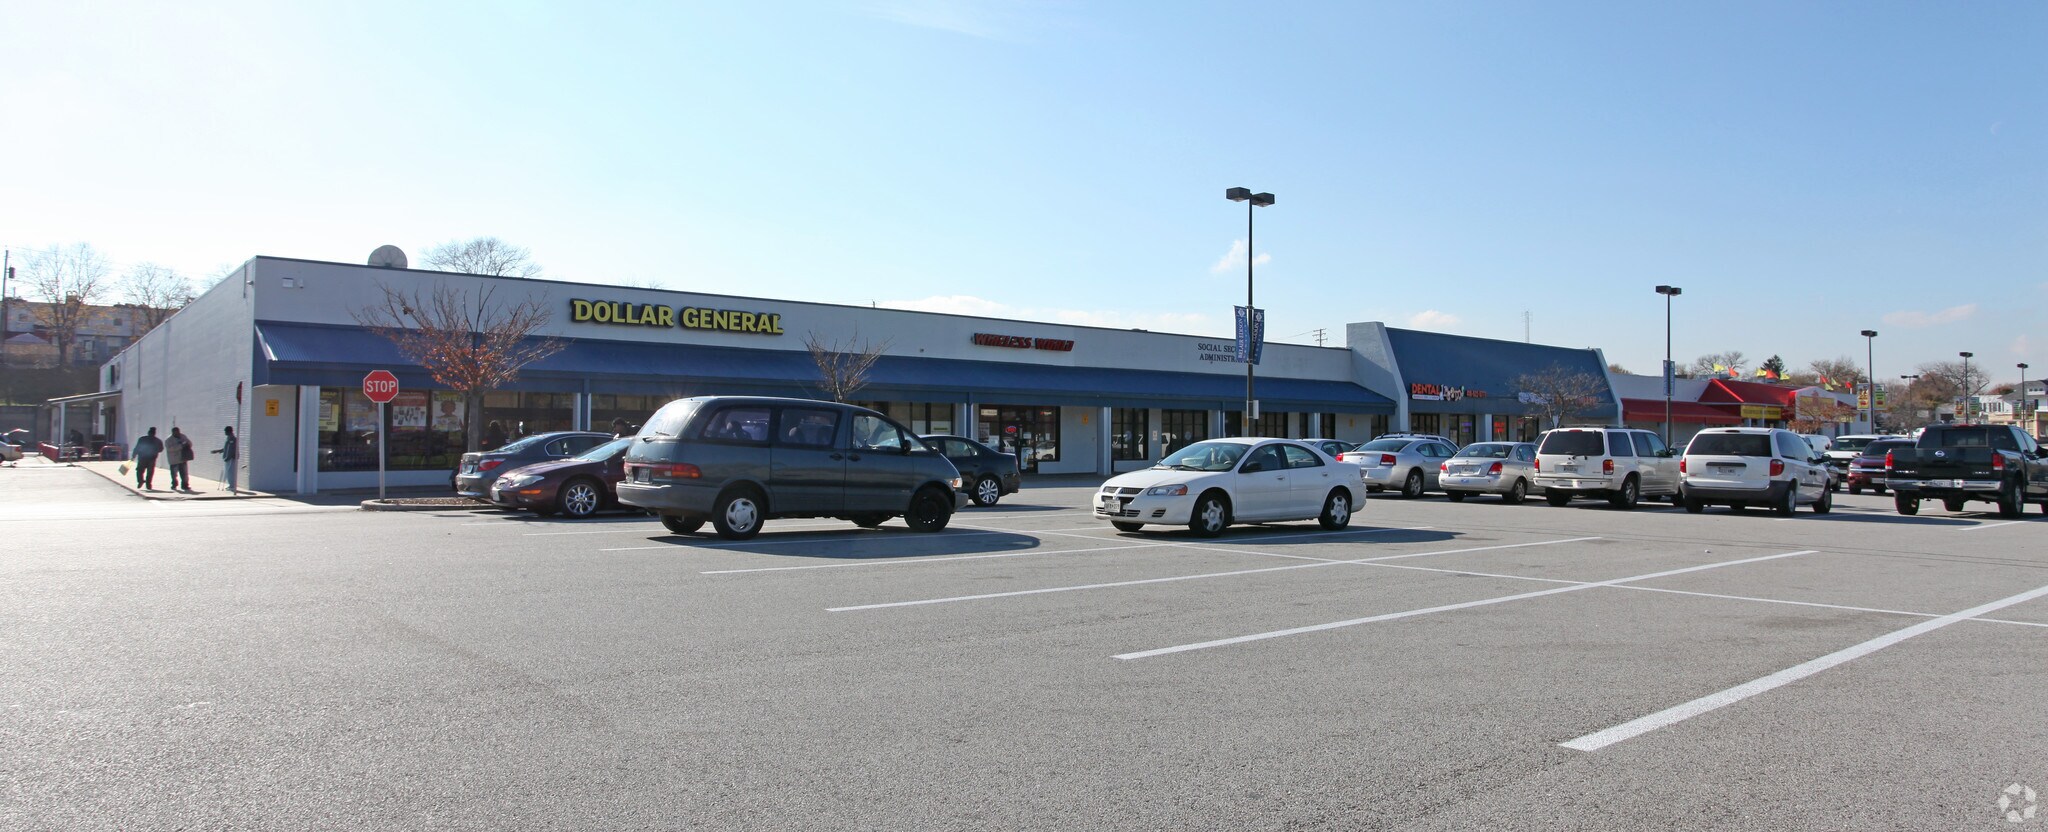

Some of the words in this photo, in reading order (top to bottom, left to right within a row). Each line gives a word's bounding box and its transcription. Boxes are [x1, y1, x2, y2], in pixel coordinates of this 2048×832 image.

[572, 299, 674, 327] DOLLAR
[681, 306, 785, 335] GENERAL
[1197, 343, 1222, 352] SOCIAL
[1199, 353, 1249, 363] ADMINISTR
[366, 380, 396, 393] STOP
[1411, 383, 1440, 396] DENTAL
